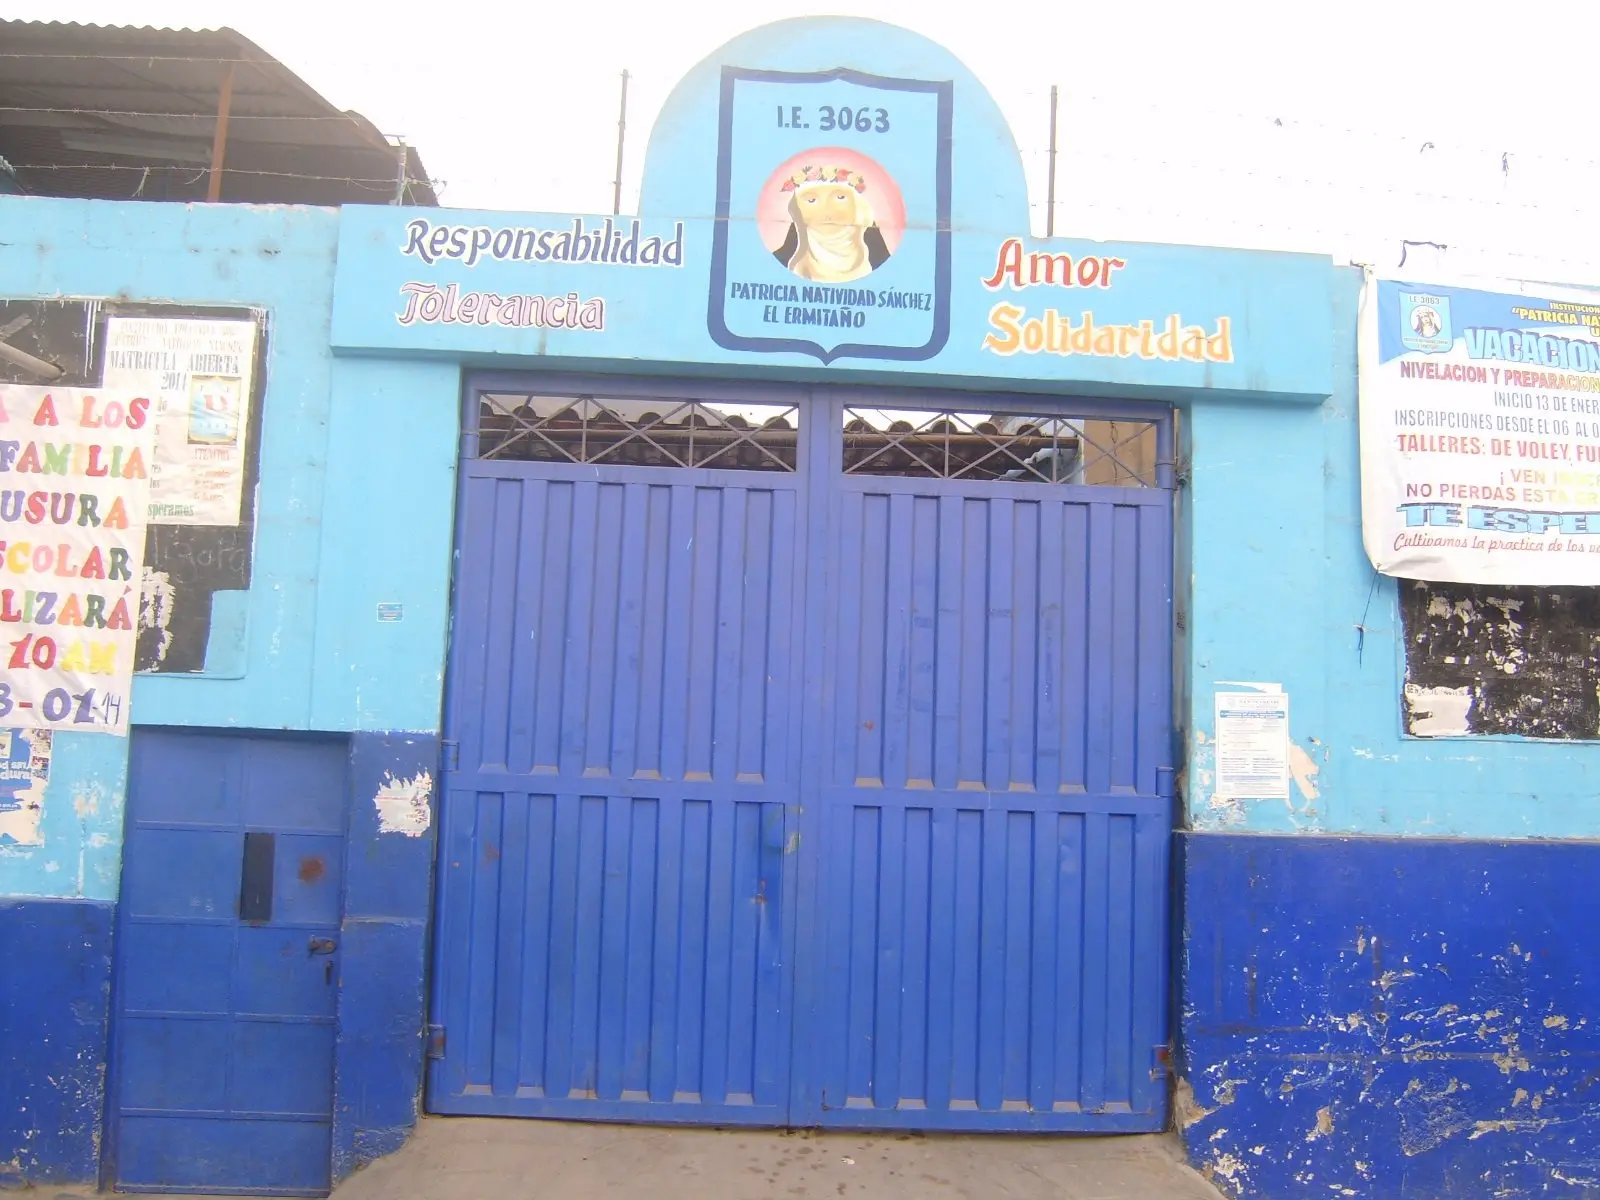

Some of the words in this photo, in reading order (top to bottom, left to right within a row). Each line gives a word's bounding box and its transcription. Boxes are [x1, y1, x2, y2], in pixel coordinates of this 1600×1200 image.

[777, 105, 810, 129] I.E.
[818, 105, 890, 134] 3063
[402, 217, 683, 266] Responsabilidad
[983, 238, 1126, 288] Amor
[398, 281, 604, 330] Tolerancia
[731, 282, 799, 302] PATRICIA
[802, 286, 876, 307] NATIVIDAD
[878, 287, 933, 311] SÁNCHEZ
[763, 305, 779, 323] EL
[784, 306, 866, 329] ERMITAÑO
[983, 302, 1233, 362] Solidaridad
[186, 353, 240, 374] ABIERTA
[1463, 326, 1600, 374] VACACION
[1400, 361, 1487, 384] NIVELACION
[1490, 367, 1500, 385] Y
[1503, 369, 1600, 394] PREPARACION
[33, 393, 60, 427] A
[79, 395, 150, 430] LOS
[1494, 391, 1533, 409] INICIO
[1536, 394, 1549, 411] 13
[1553, 396, 1568, 412] DE
[1394, 408, 1493, 430] INSCRIPCIONES
[1496, 415, 1534, 433] DESDE
[1537, 418, 1550, 435] EL
[1553, 420, 1569, 436] 06
[1576, 422, 1589, 438] AL
[0, 439, 148, 480] FAMILIA
[1396, 433, 1486, 456] TALLERES:
[1491, 438, 1512, 457] DE
[1576, 444, 1600, 463] FU
[0, 489, 130, 530] USURA
[1406, 483, 1433, 498] NO
[1440, 483, 1516, 502] PIERDAS
[1522, 488, 1568, 504] ESTA
[1396, 502, 1463, 528] TE
[1394, 532, 1468, 552] Cultivamos
[1471, 535, 1486, 550] la
[1487, 537, 1543, 554] practica
[1547, 537, 1564, 552] de
[1566, 539, 1585, 553] los
[0, 585, 133, 631] LIZARÁ
[7, 632, 58, 671] 10
[60, 637, 118, 676] AM
